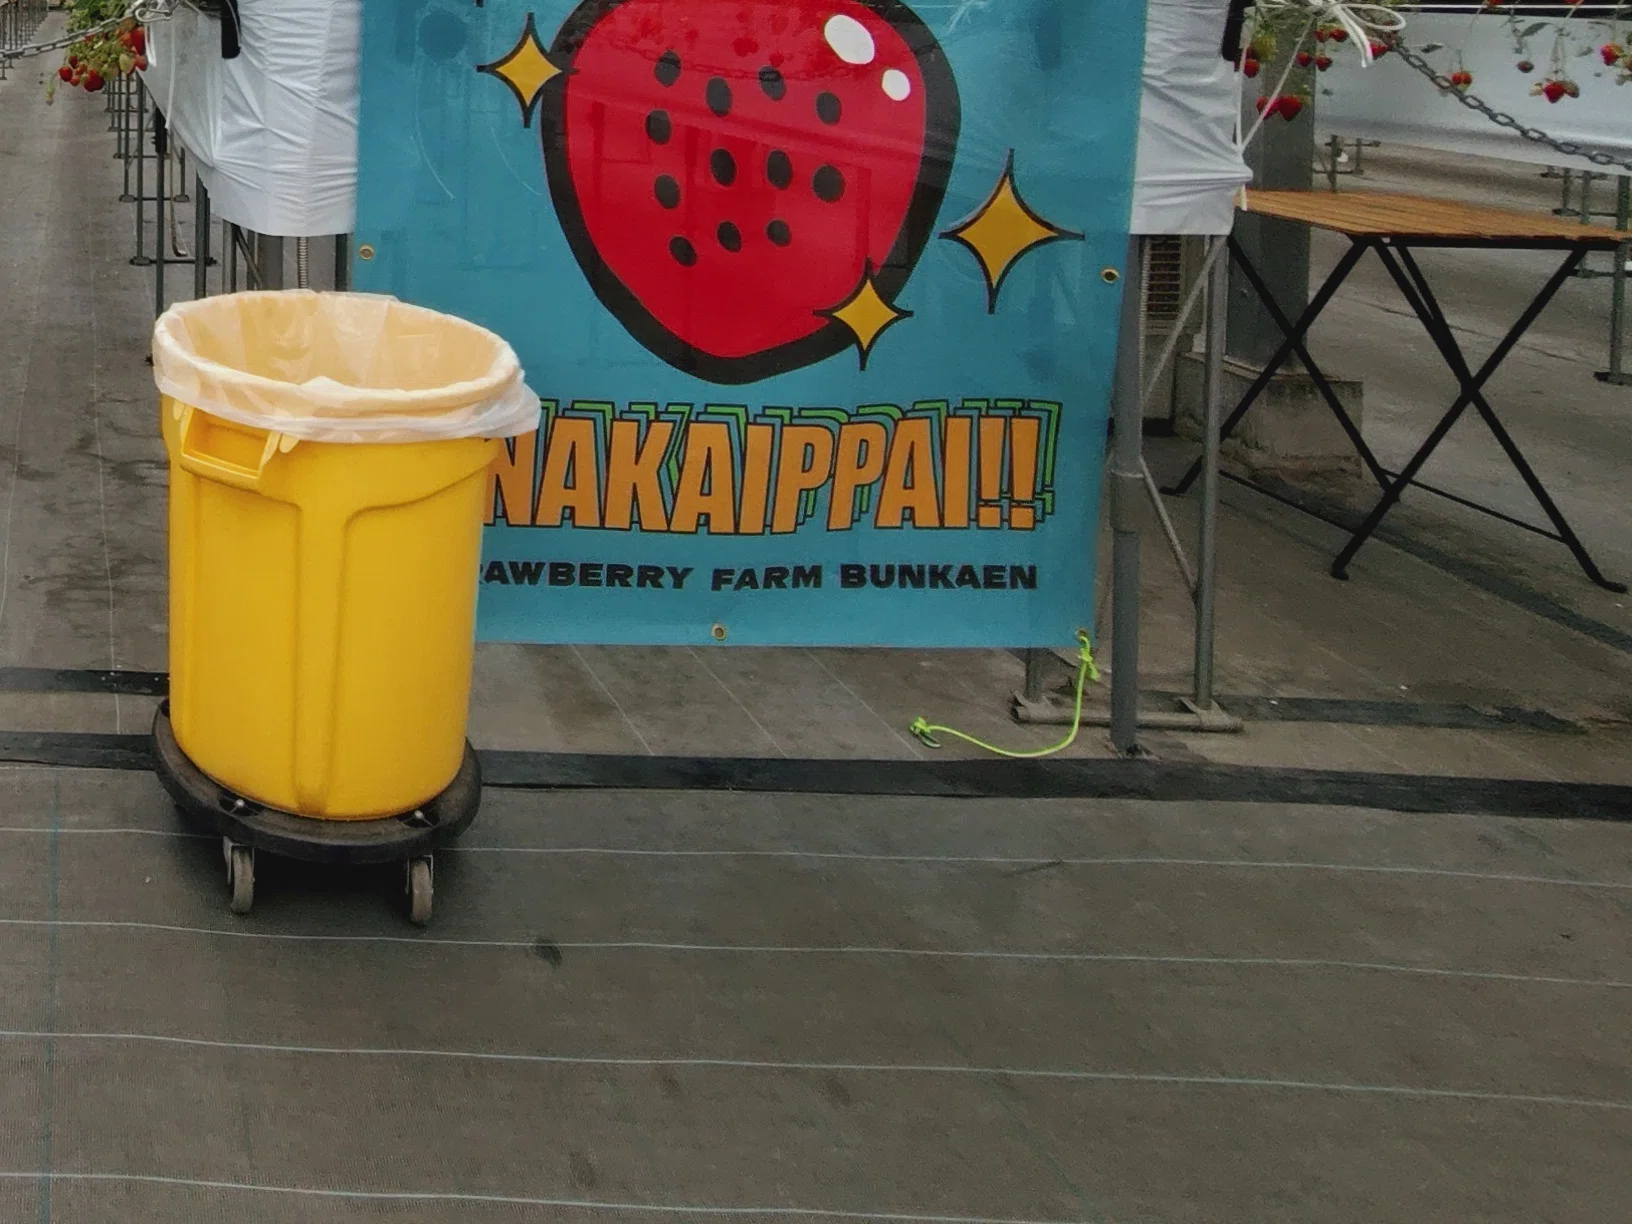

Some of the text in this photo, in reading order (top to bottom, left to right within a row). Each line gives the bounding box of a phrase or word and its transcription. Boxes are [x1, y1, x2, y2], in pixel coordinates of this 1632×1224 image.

[479, 560, 1038, 592] AWBERRY FARM BUNKAEN
